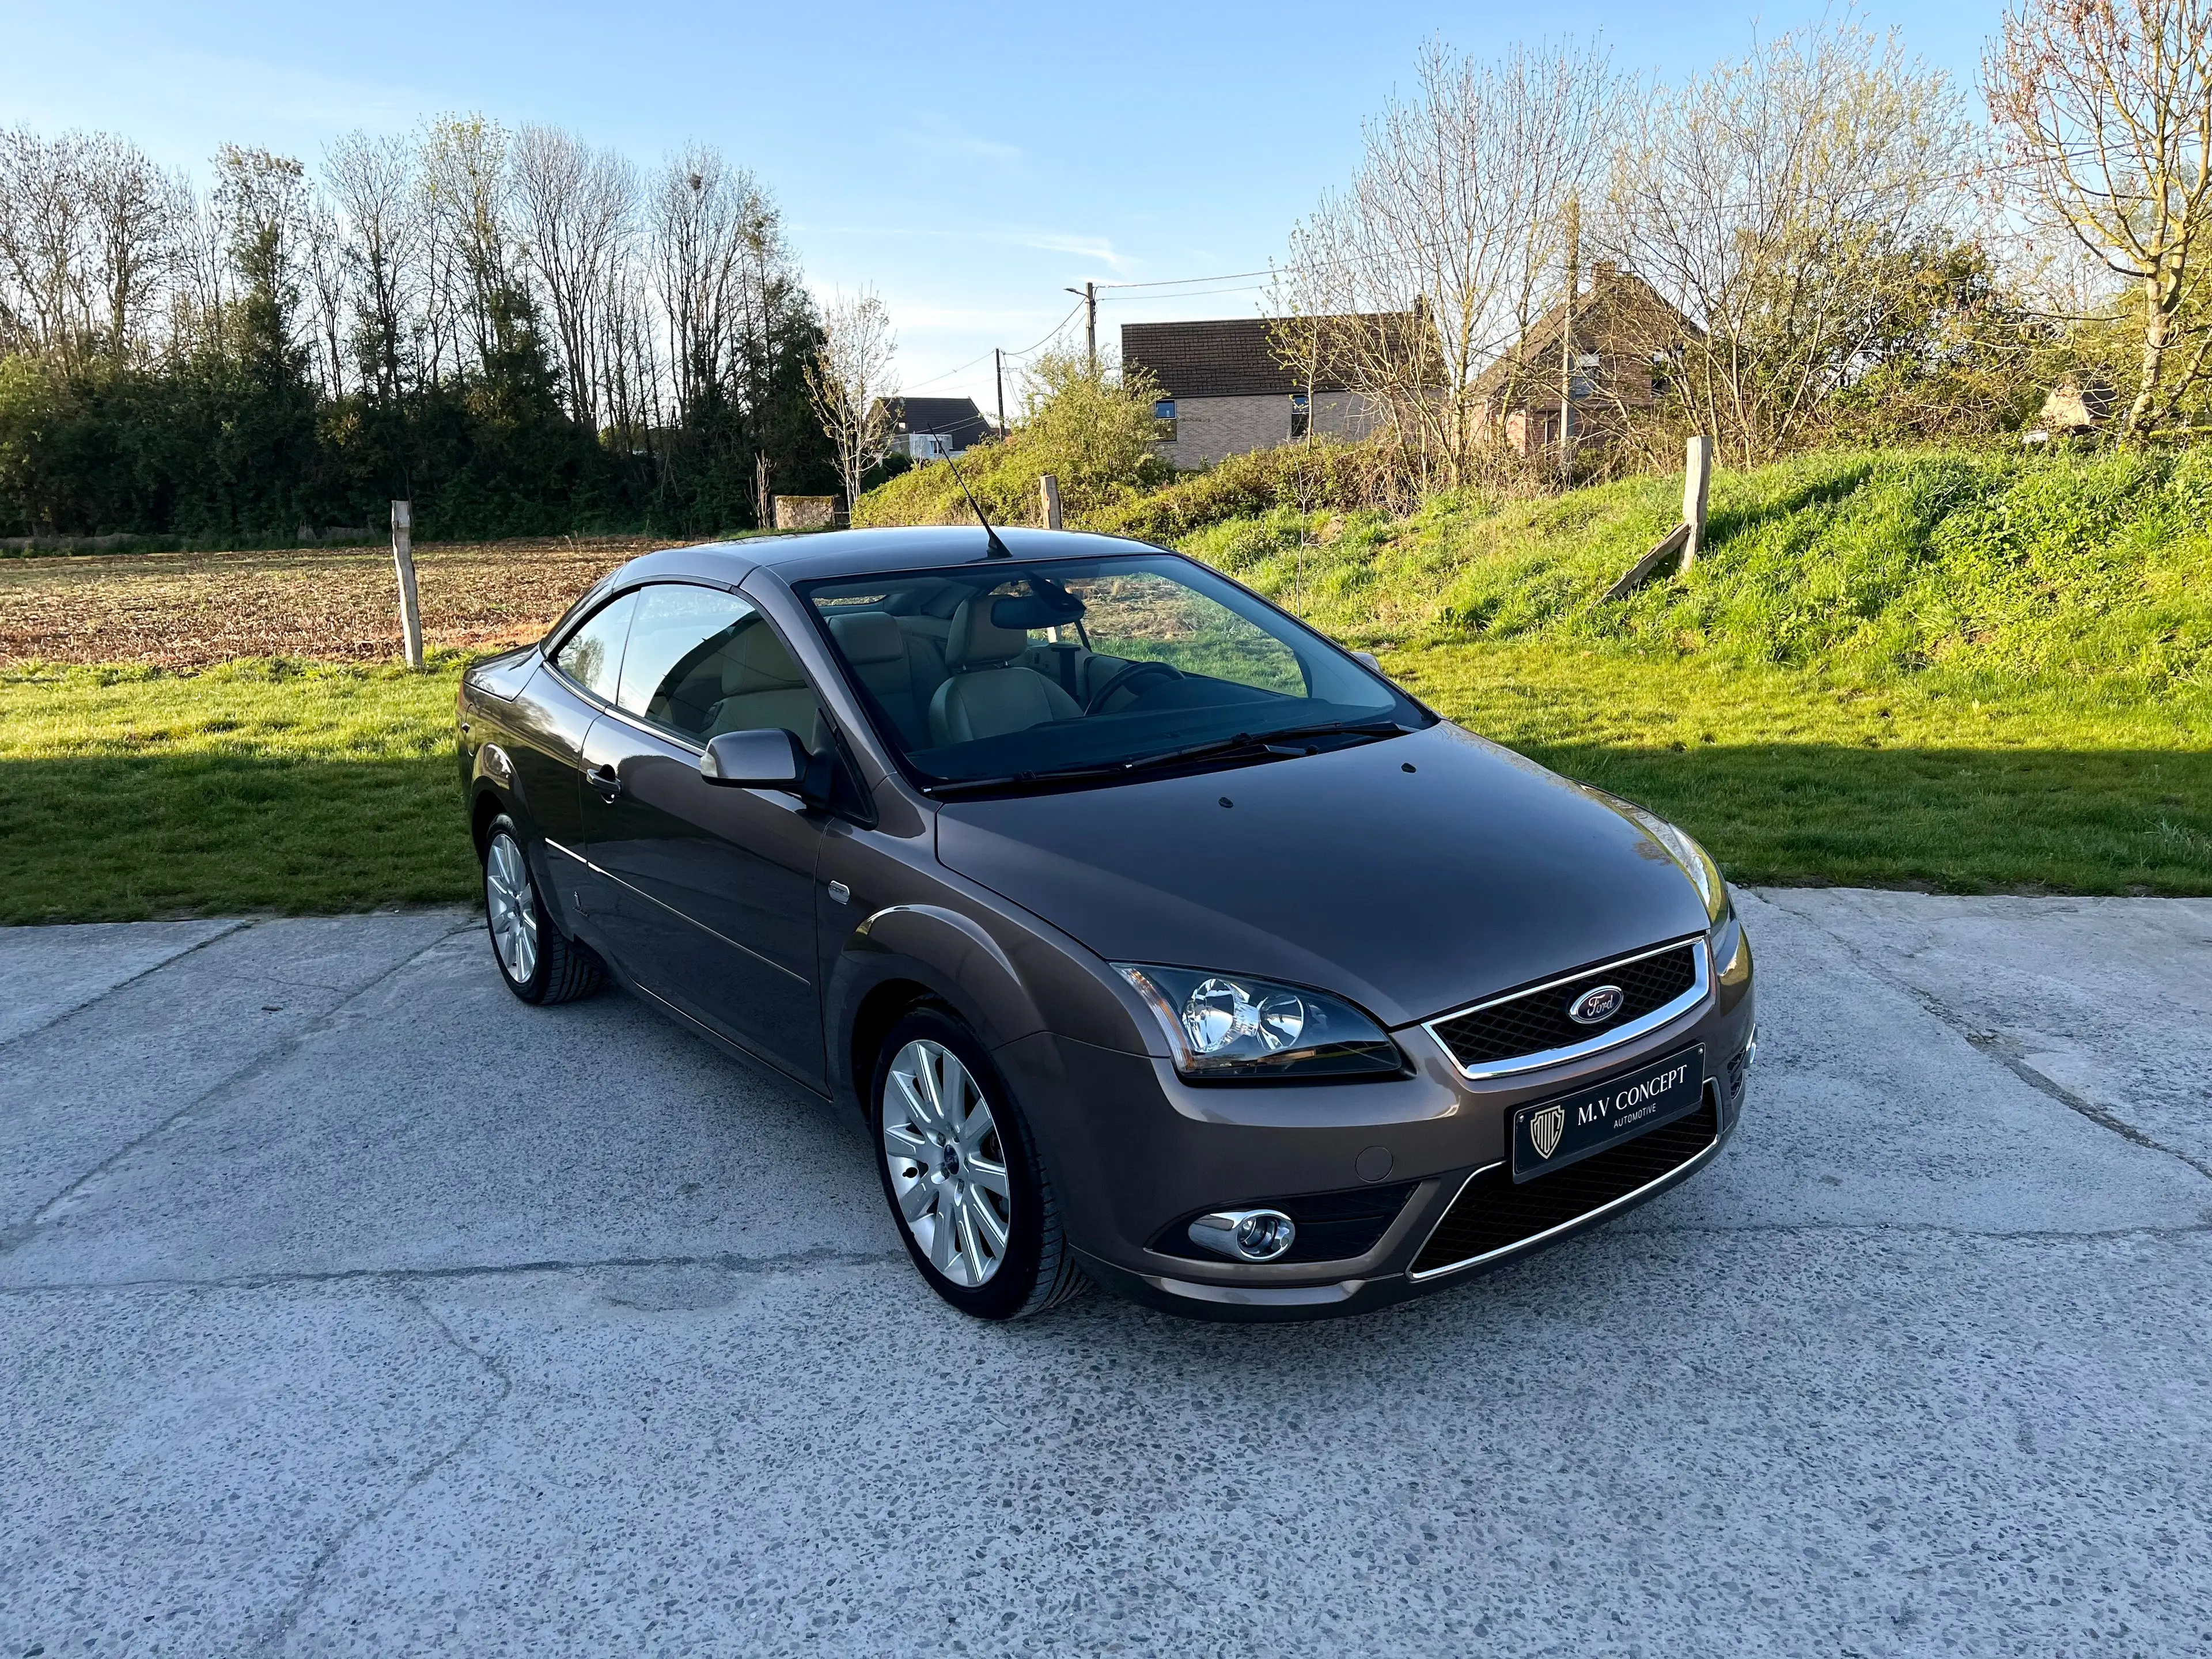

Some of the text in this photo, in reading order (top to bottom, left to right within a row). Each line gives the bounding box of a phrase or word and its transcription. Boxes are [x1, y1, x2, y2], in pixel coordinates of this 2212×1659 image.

[1587, 994, 1613, 1017] Ford
[1578, 1064, 1687, 1126] M.V CONCEPT
[1613, 1103, 1656, 1129] AUTOMOTIVE
